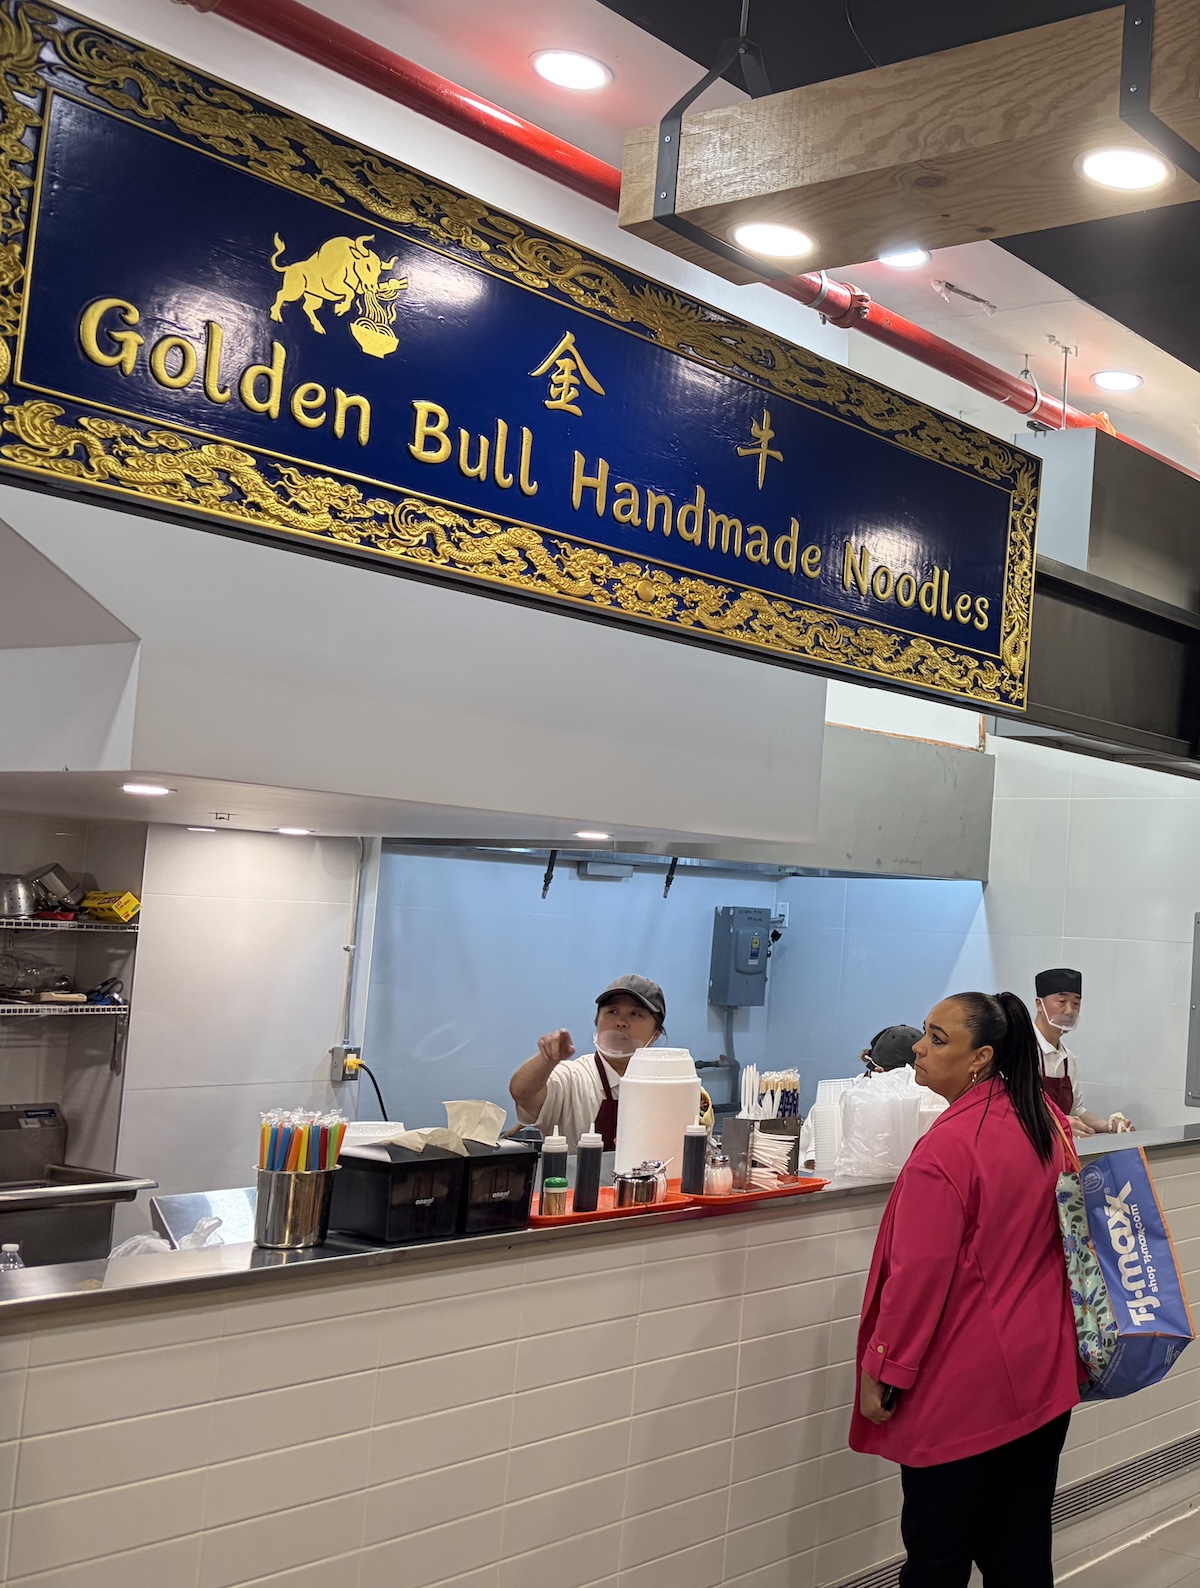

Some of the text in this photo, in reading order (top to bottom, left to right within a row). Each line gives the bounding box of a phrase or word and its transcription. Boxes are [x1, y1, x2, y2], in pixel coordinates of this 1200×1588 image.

[79, 297, 990, 632] Golden Bull Handmade Noodles
[529, 331, 785, 491] 金 牛
[1146, 1264, 1159, 1293] shop
